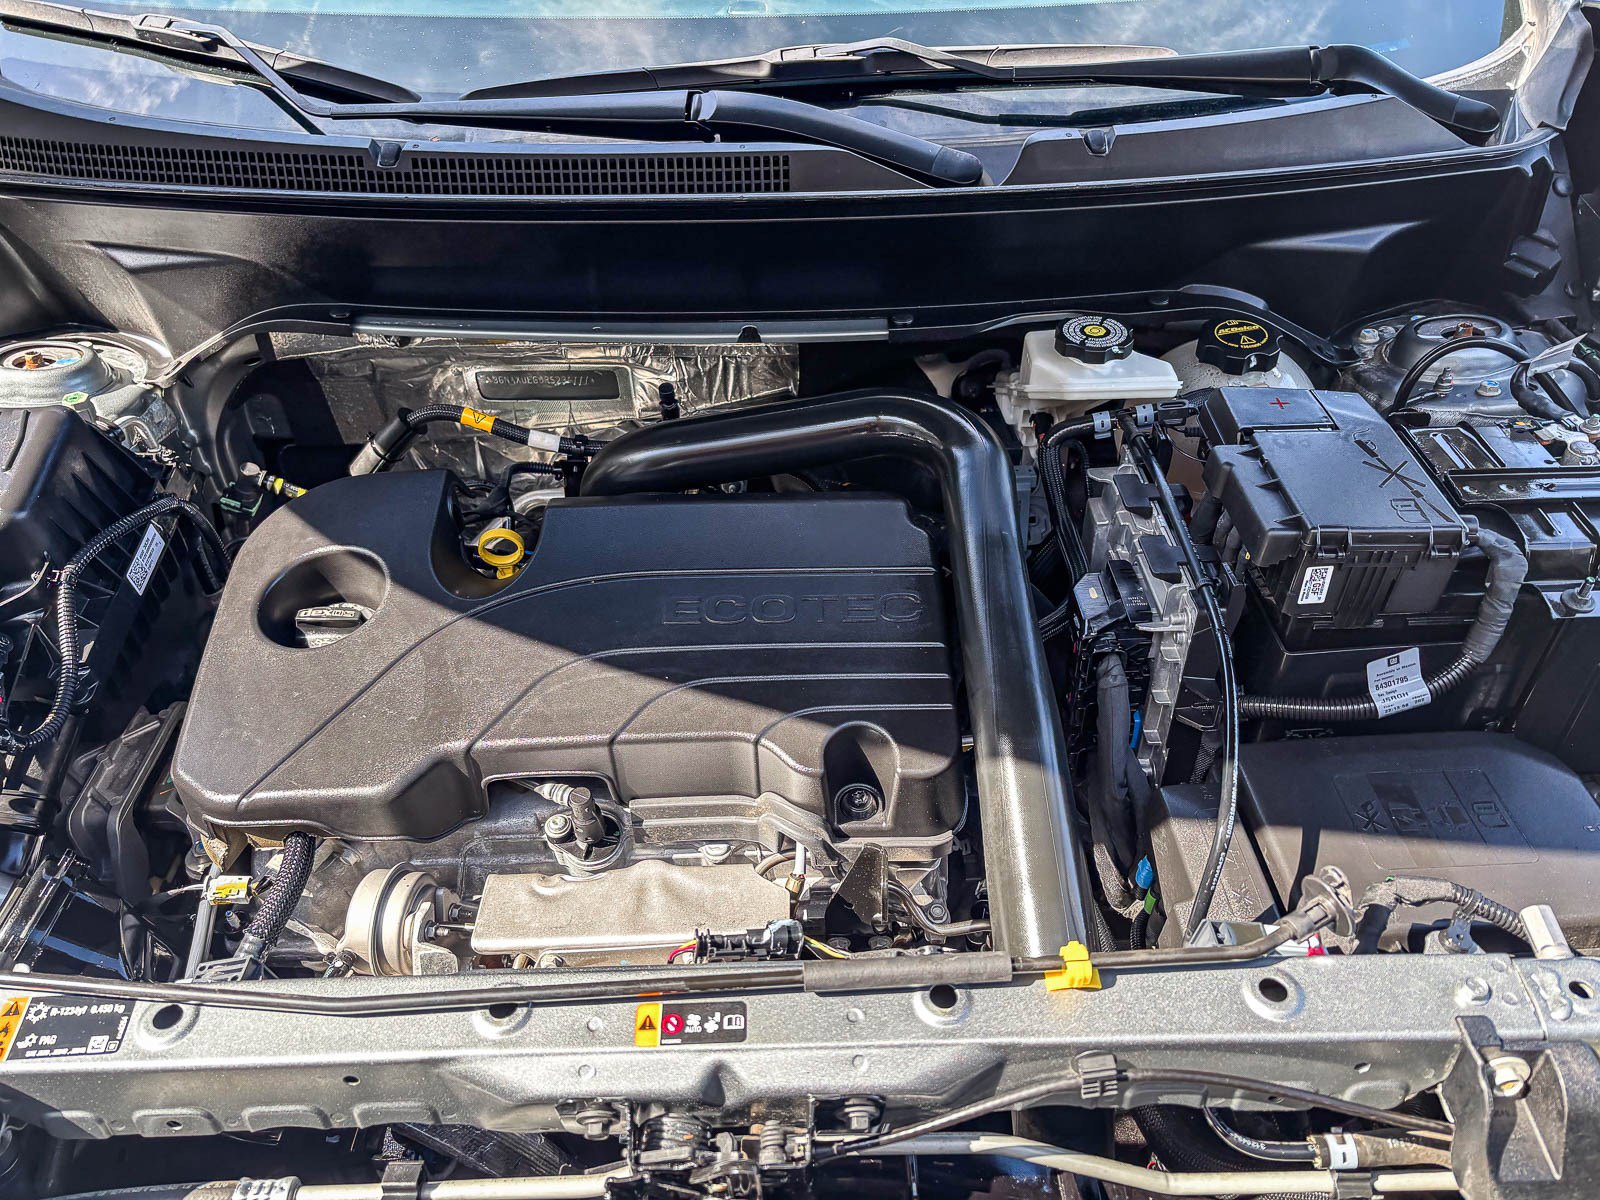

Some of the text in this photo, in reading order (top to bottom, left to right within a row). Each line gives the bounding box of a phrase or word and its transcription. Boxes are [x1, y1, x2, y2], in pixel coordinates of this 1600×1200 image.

[299, 608, 355, 617] dexos
[663, 593, 923, 624] ECOTEC
[1375, 676, 1409, 691] 84301795
[684, 1026, 702, 1034] AUTO
[39, 1035, 58, 1045] PAG
